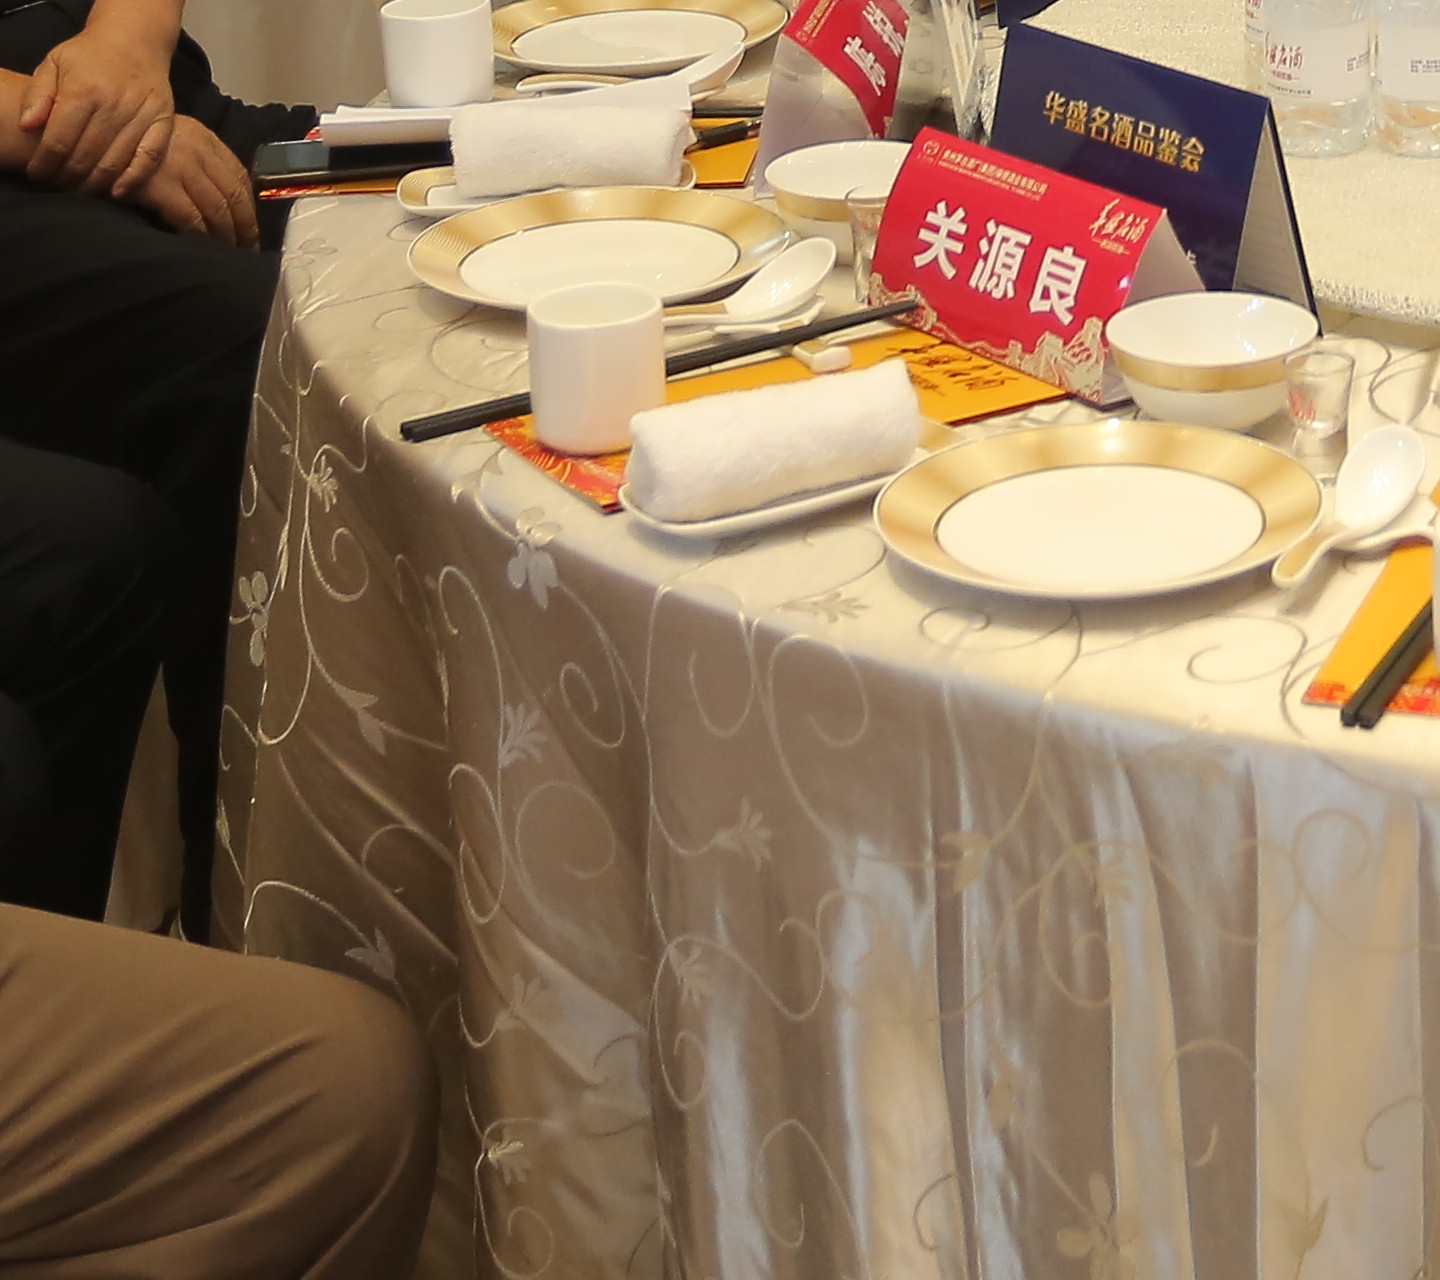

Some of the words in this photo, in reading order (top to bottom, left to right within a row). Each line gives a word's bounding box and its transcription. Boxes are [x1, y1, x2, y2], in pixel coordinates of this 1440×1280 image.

[1042, 89, 1207, 174] 华盛名酒品鉴会
[912, 198, 1089, 327] 关源良
